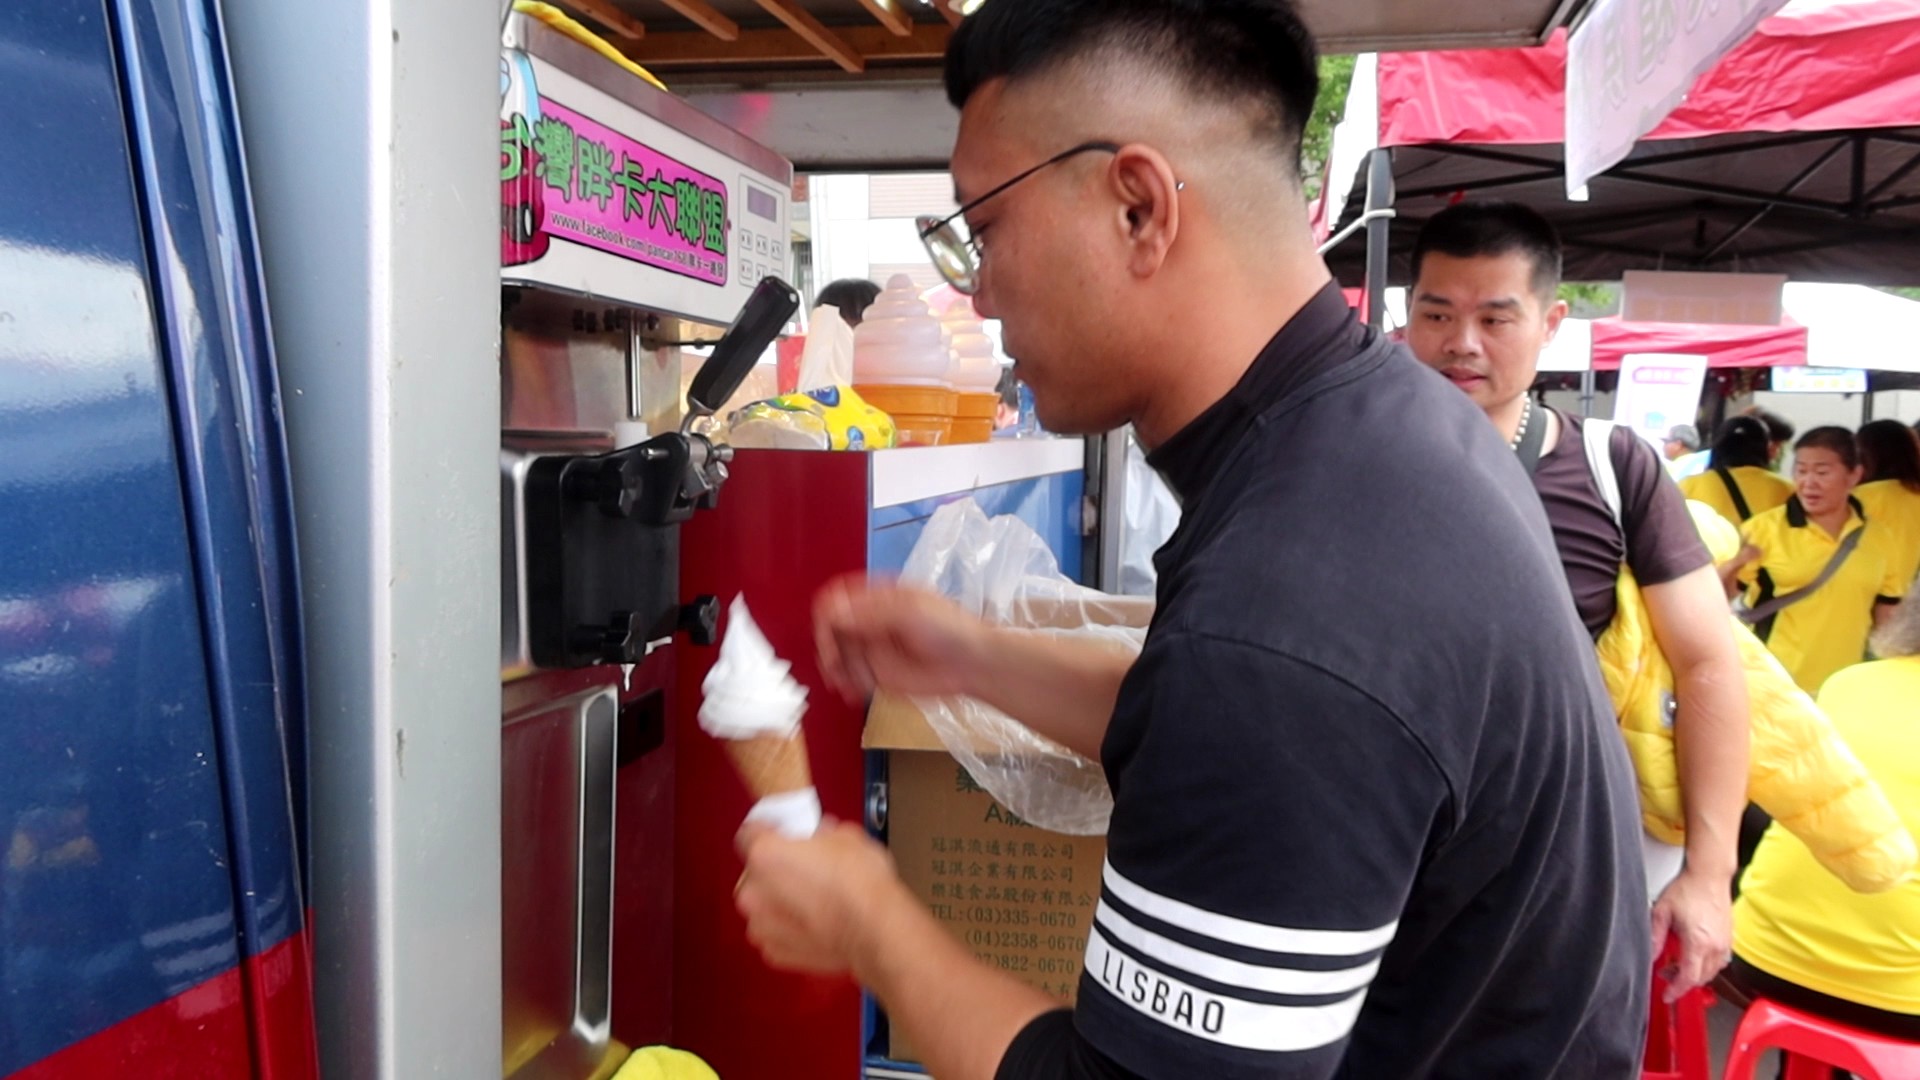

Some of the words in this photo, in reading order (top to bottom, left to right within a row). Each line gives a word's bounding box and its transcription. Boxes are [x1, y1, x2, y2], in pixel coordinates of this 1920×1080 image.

[965, 929, 1085, 952] (04)2358-0670
[975, 952, 1076, 975] 07)822-0670
[1102, 949, 1225, 1034] LLSBAO
